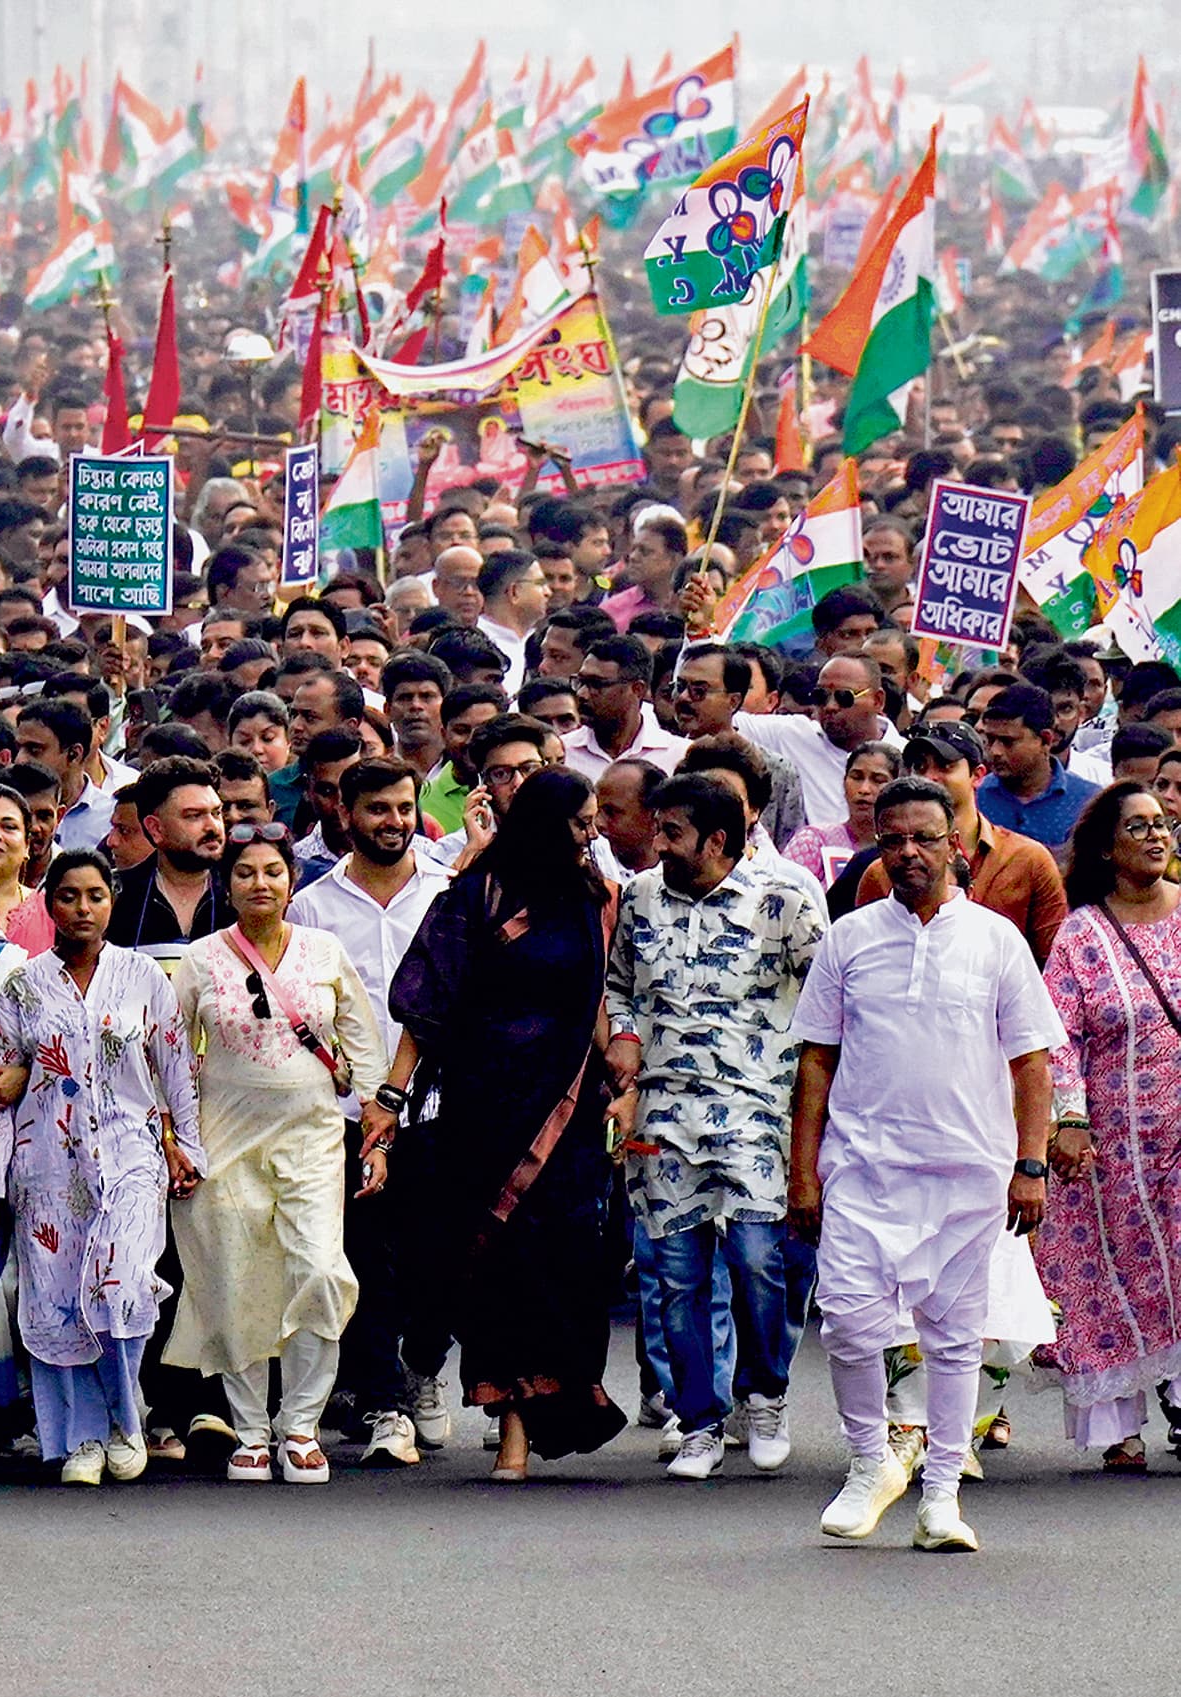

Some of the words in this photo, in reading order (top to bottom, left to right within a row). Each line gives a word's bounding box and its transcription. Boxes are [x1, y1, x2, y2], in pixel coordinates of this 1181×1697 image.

[78, 464, 115, 489] চিন্তার
[120, 470, 164, 489] কোনও
[78, 492, 122, 511] কারণ
[941, 492, 1021, 530] আমার
[102, 516, 132, 533] থেকে
[75, 534, 108, 557] তালিকা
[933, 530, 1014, 565] ভোট
[928, 558, 1011, 602] আমার
[77, 584, 114, 604] পাশে
[120, 583, 160, 606] আছি
[921, 596, 1004, 641] অধিকার
